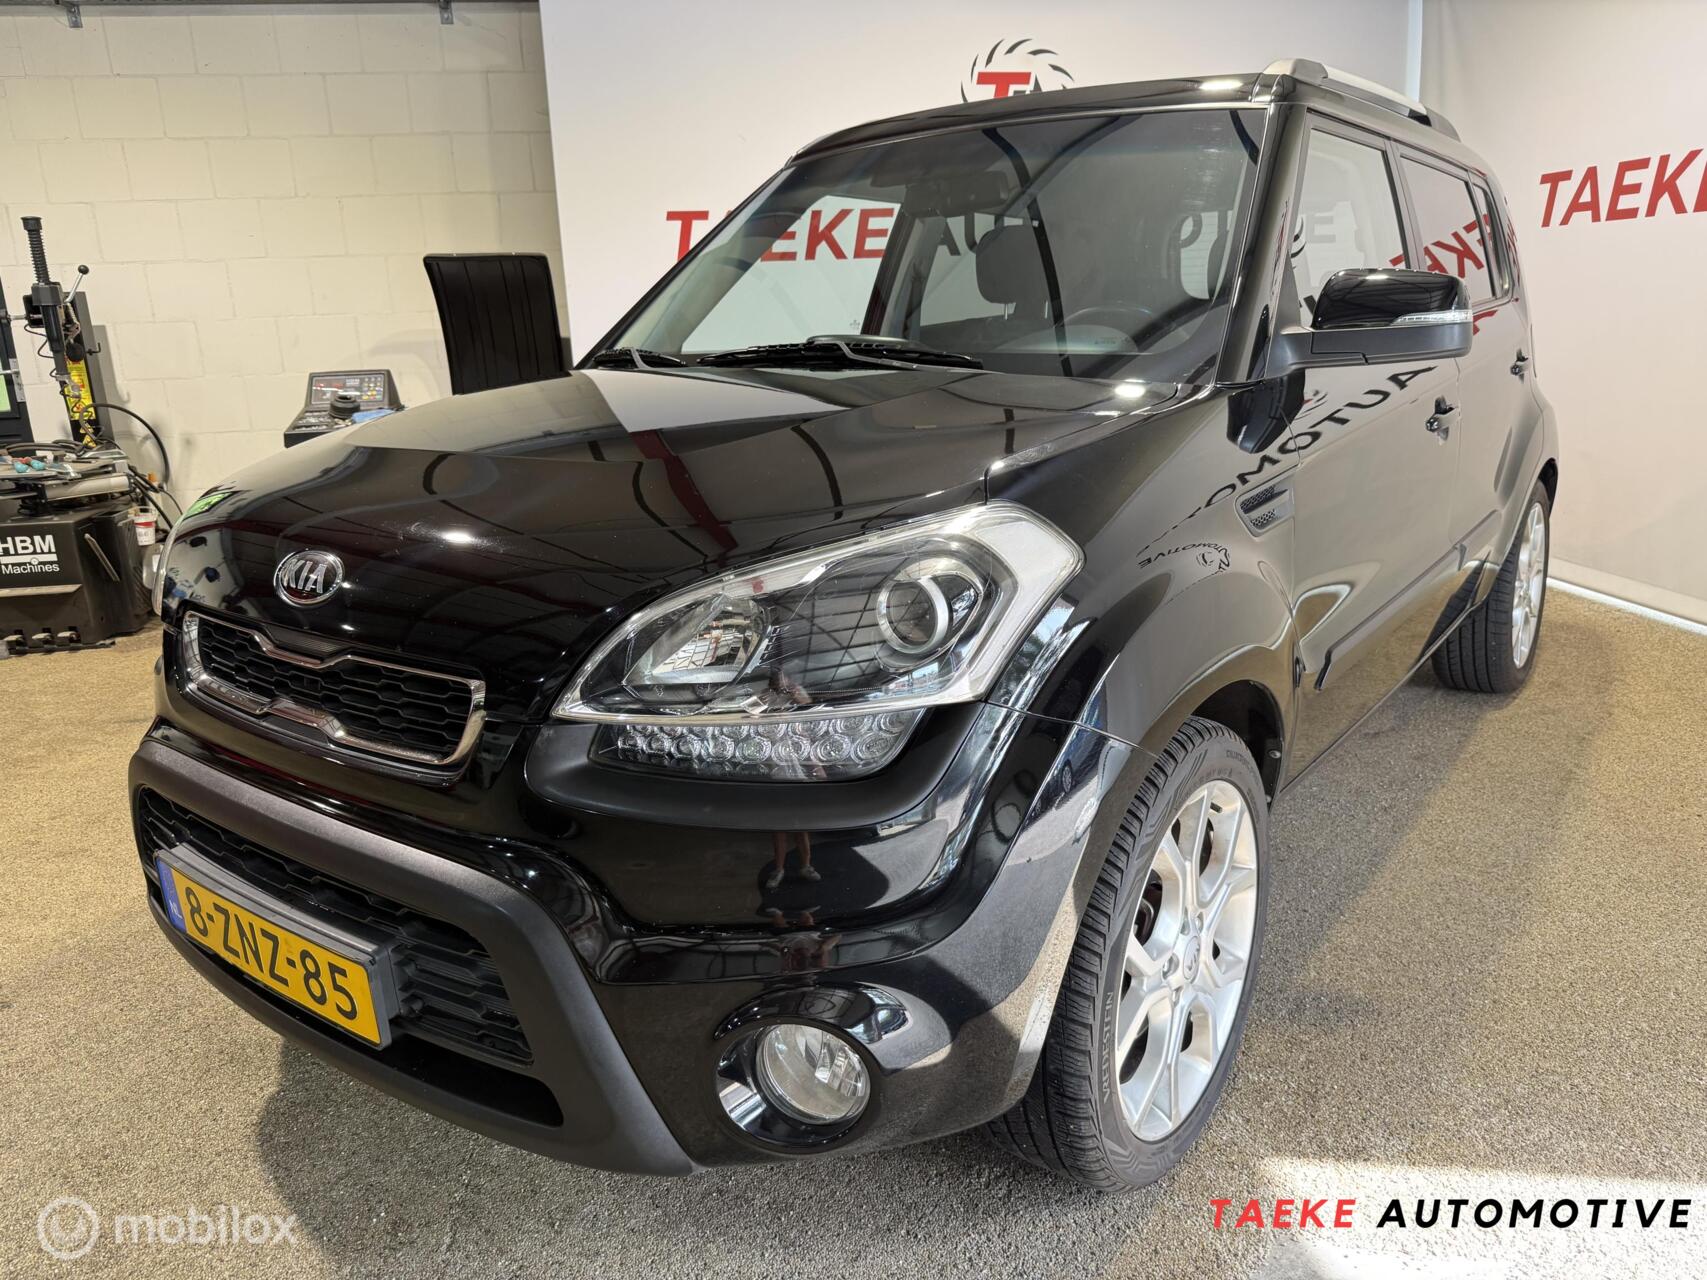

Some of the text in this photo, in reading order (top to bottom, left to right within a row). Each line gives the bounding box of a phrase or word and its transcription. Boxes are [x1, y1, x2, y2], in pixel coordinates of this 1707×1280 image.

[1540, 148, 1707, 228] TAEK
[0, 534, 56, 554] HBM
[1, 562, 60, 575] Machines
[281, 558, 328, 594] KIA
[184, 886, 359, 1021] 8-ZNZ-85
[1101, 991, 1115, 1105] VREDESTEIN
